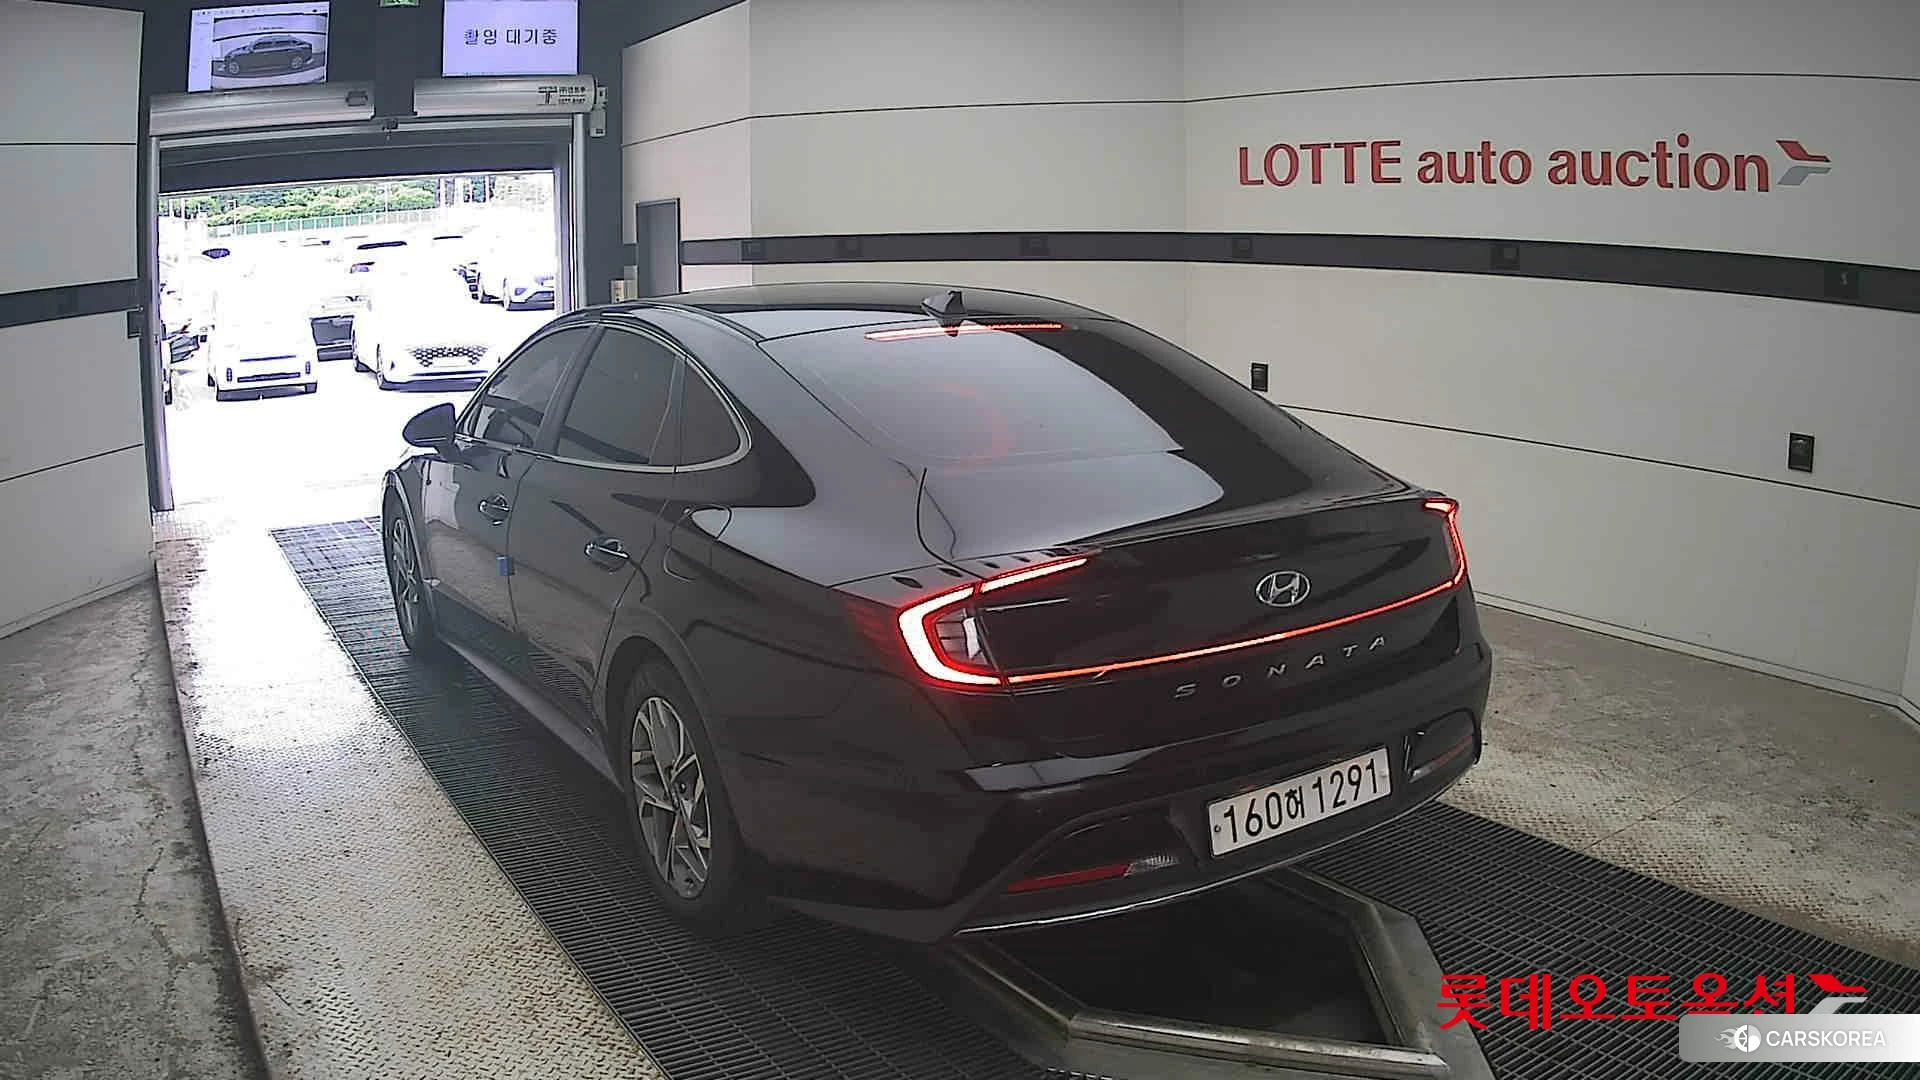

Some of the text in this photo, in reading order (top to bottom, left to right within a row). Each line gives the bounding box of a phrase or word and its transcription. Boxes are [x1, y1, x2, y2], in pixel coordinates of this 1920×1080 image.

[506, 28, 558, 45] 대기중
[1238, 132, 1770, 193] LOTTE auto auction
[1174, 635, 1386, 699] SONATA
